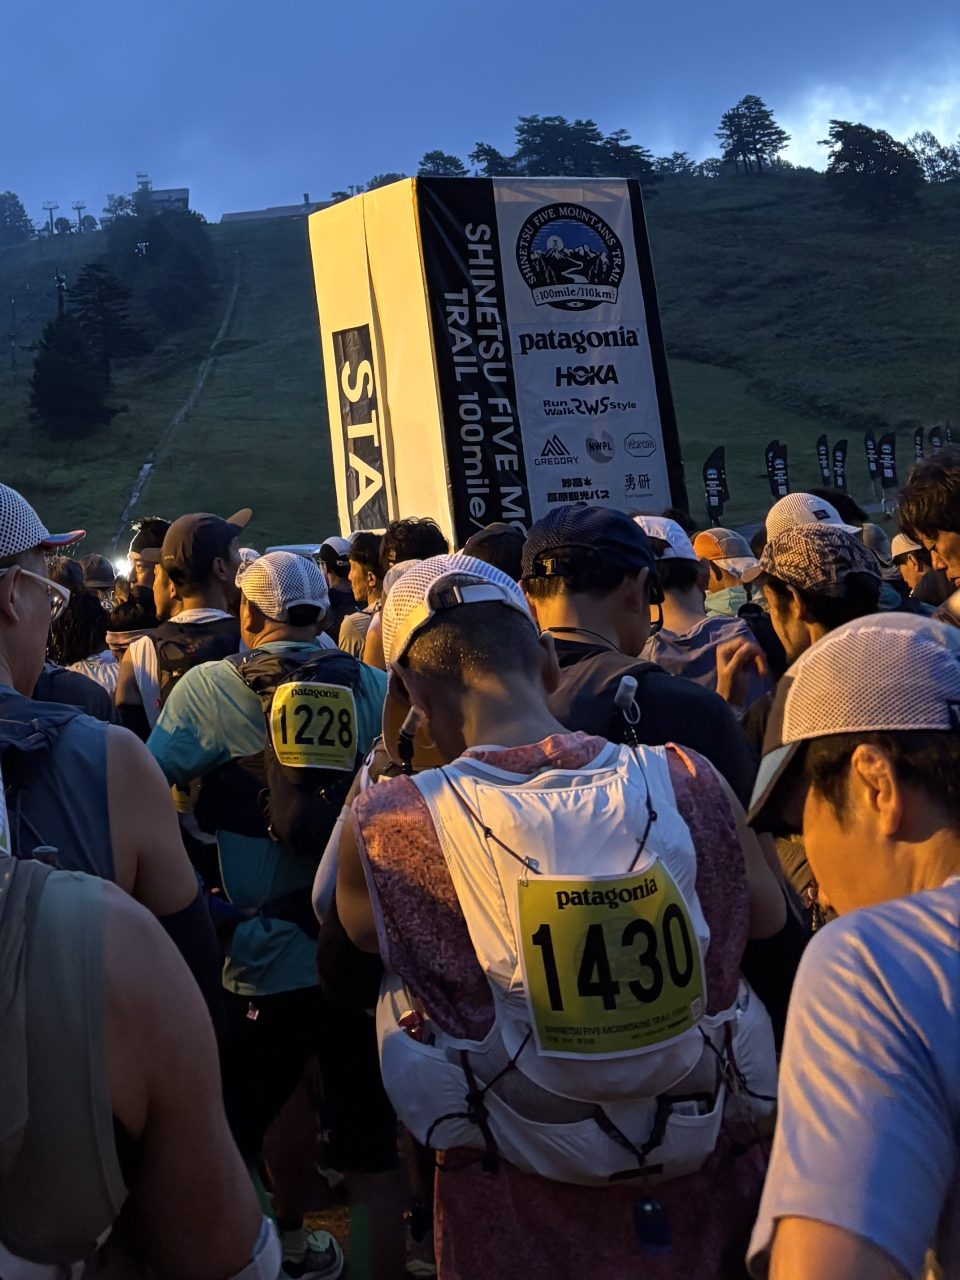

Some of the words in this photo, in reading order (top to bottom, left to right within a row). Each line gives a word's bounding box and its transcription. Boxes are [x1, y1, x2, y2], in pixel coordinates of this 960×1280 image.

[519, 224, 537, 284] SHINETSU
[533, 208, 556, 227] FIVE
[558, 206, 616, 246] MOUNTAINS
[608, 248, 622, 283] TRAIL
[540, 286, 612, 300] 100mile/110km
[443, 288, 478, 382] TRAIL
[465, 222, 507, 383] SHINETSU
[487, 397, 520, 472] FIVE
[519, 325, 639, 355] patagonia
[555, 364, 619, 388] HOKA
[543, 399, 568, 408] Run
[543, 407, 576, 416] Walk
[609, 401, 637, 411] Style
[341, 359, 383, 516] STA
[589, 441, 613, 452] NWPL
[534, 455, 579, 466] GREGORY
[291, 687, 341, 699] patagonia
[278, 704, 353, 748] 1228
[556, 878, 658, 909] patagonia
[531, 903, 694, 1012] 1430
